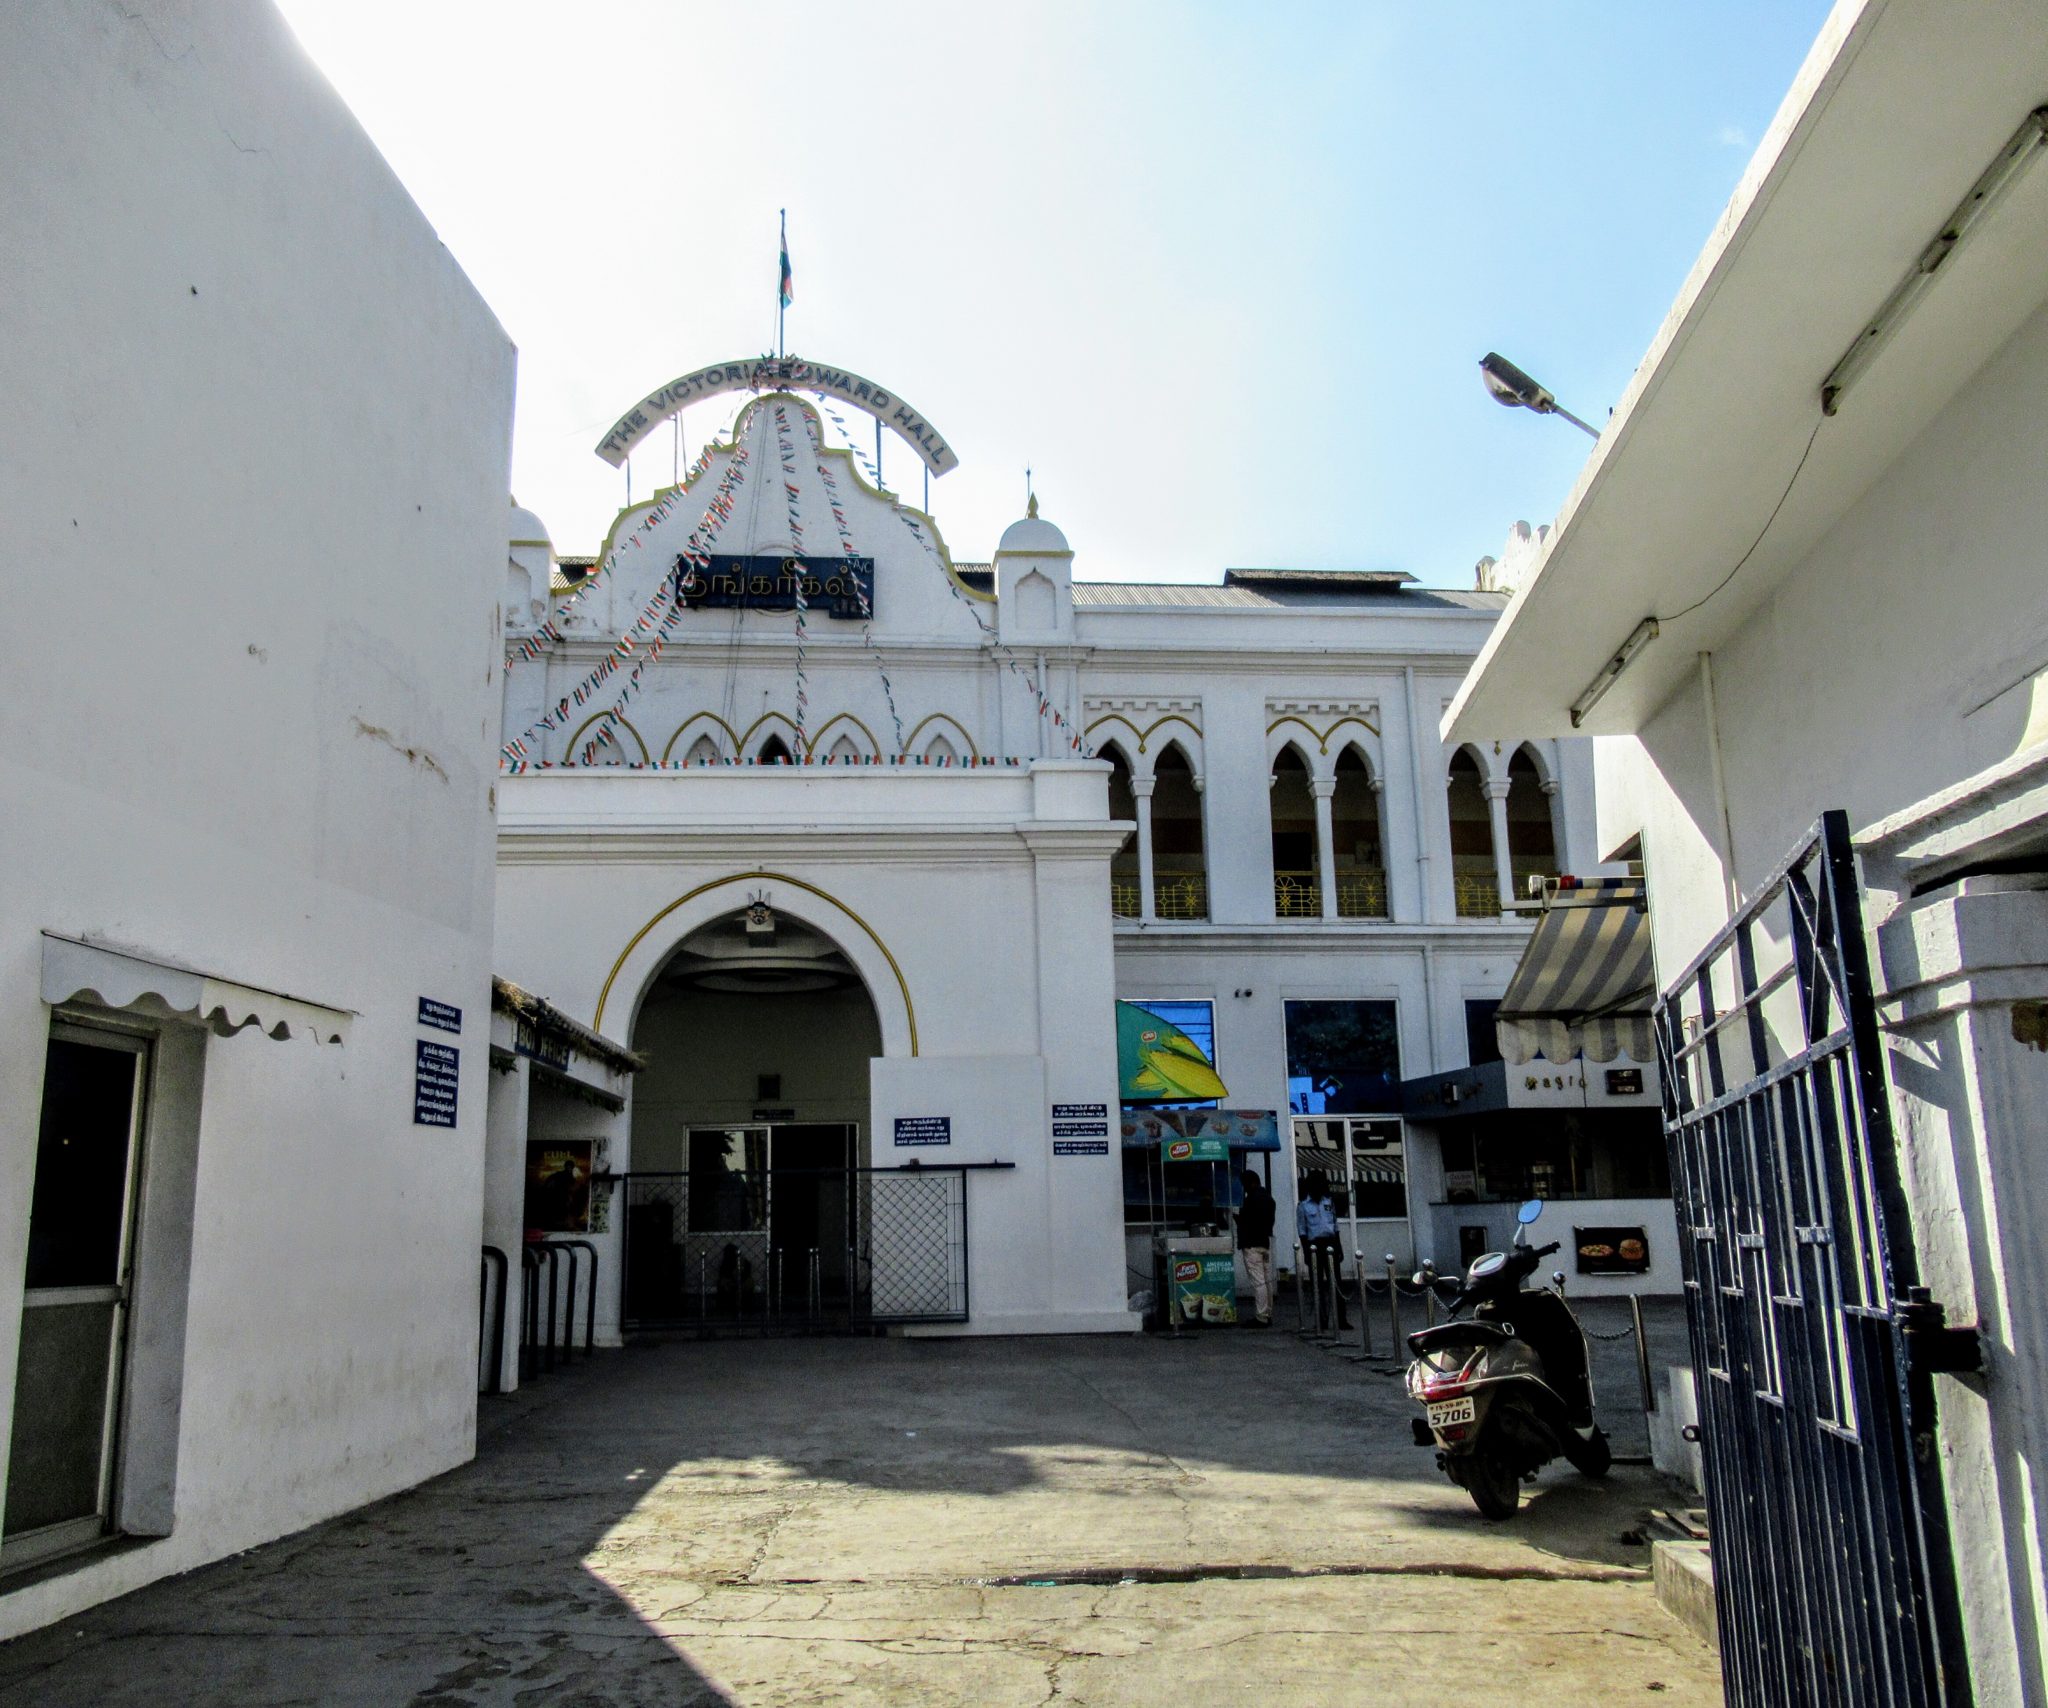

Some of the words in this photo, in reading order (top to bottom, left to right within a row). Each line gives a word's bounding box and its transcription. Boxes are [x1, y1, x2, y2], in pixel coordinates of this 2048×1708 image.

[603, 409, 648, 454] THE
[648, 363, 773, 411] VICTORIA
[779, 361, 891, 408] EDWARD
[893, 406, 949, 465] HALL
[1431, 1408, 1471, 1425] 5706
